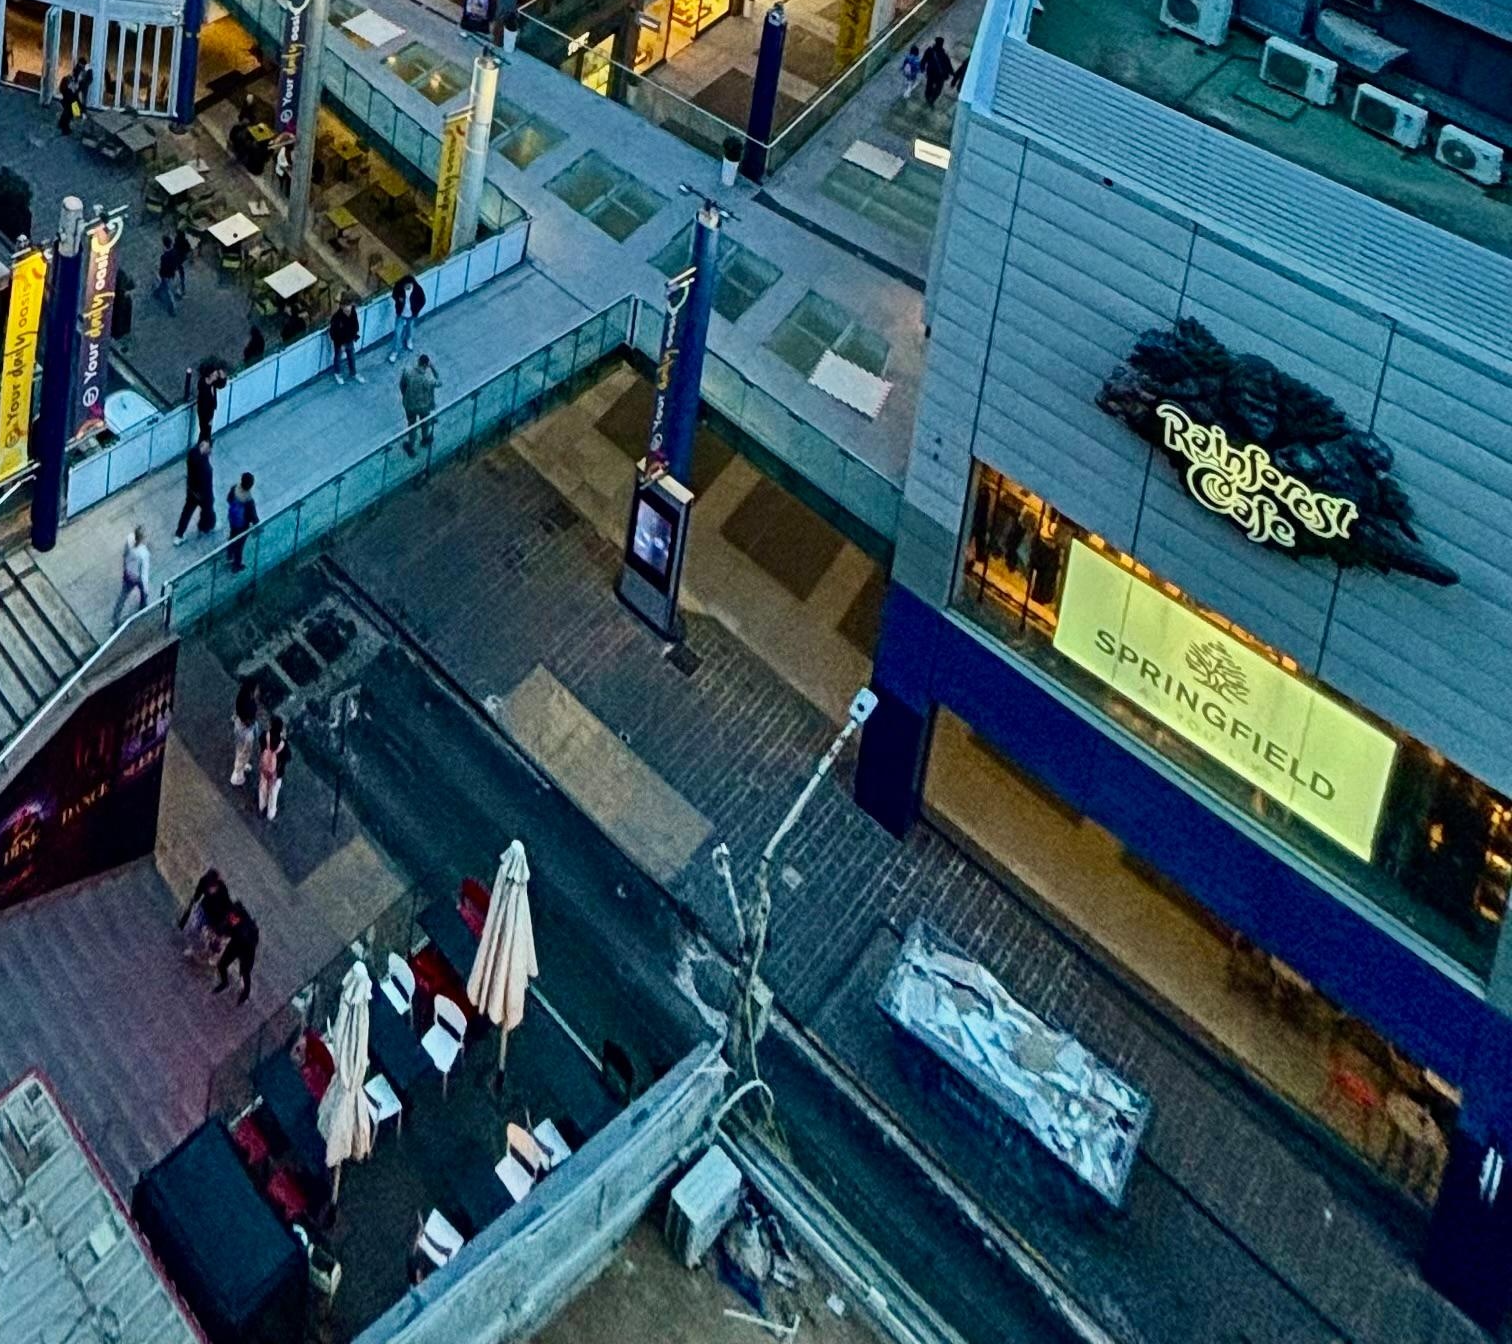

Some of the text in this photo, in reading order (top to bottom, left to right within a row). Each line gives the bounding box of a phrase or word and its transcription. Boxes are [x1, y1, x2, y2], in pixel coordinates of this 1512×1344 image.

[81, 291, 116, 340] daily
[4, 330, 39, 382] daily
[82, 343, 99, 385] Your
[5, 383, 23, 426] Your
[1155, 402, 1360, 540] Rainforest
[1186, 462, 1296, 548] Cafe
[1093, 628, 1337, 802] SPRINGFIELD
